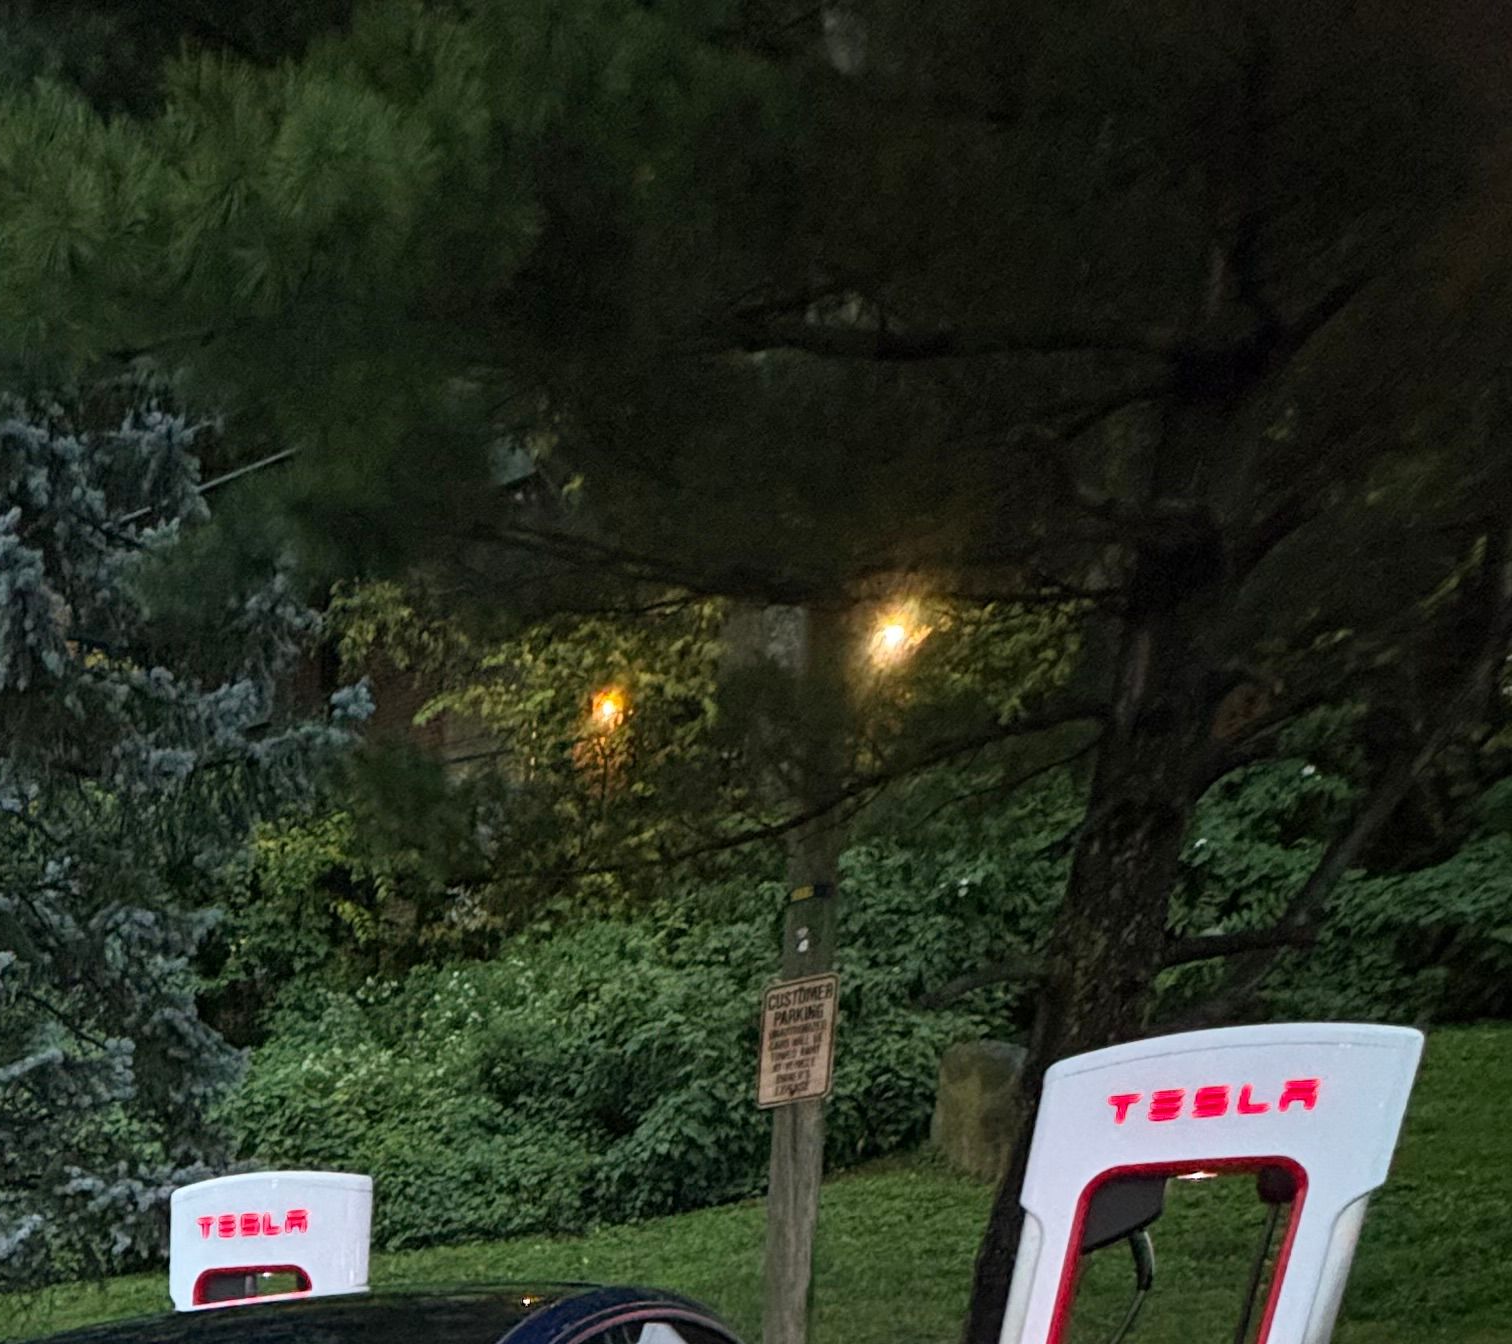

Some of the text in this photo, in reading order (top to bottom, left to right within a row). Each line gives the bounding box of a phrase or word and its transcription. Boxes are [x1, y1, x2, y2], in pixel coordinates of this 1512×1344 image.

[768, 983, 833, 1011] CUSTOMER
[773, 1003, 825, 1027] PARKING
[1107, 1078, 1321, 1125] TESLA
[196, 1208, 311, 1240] TESLA
